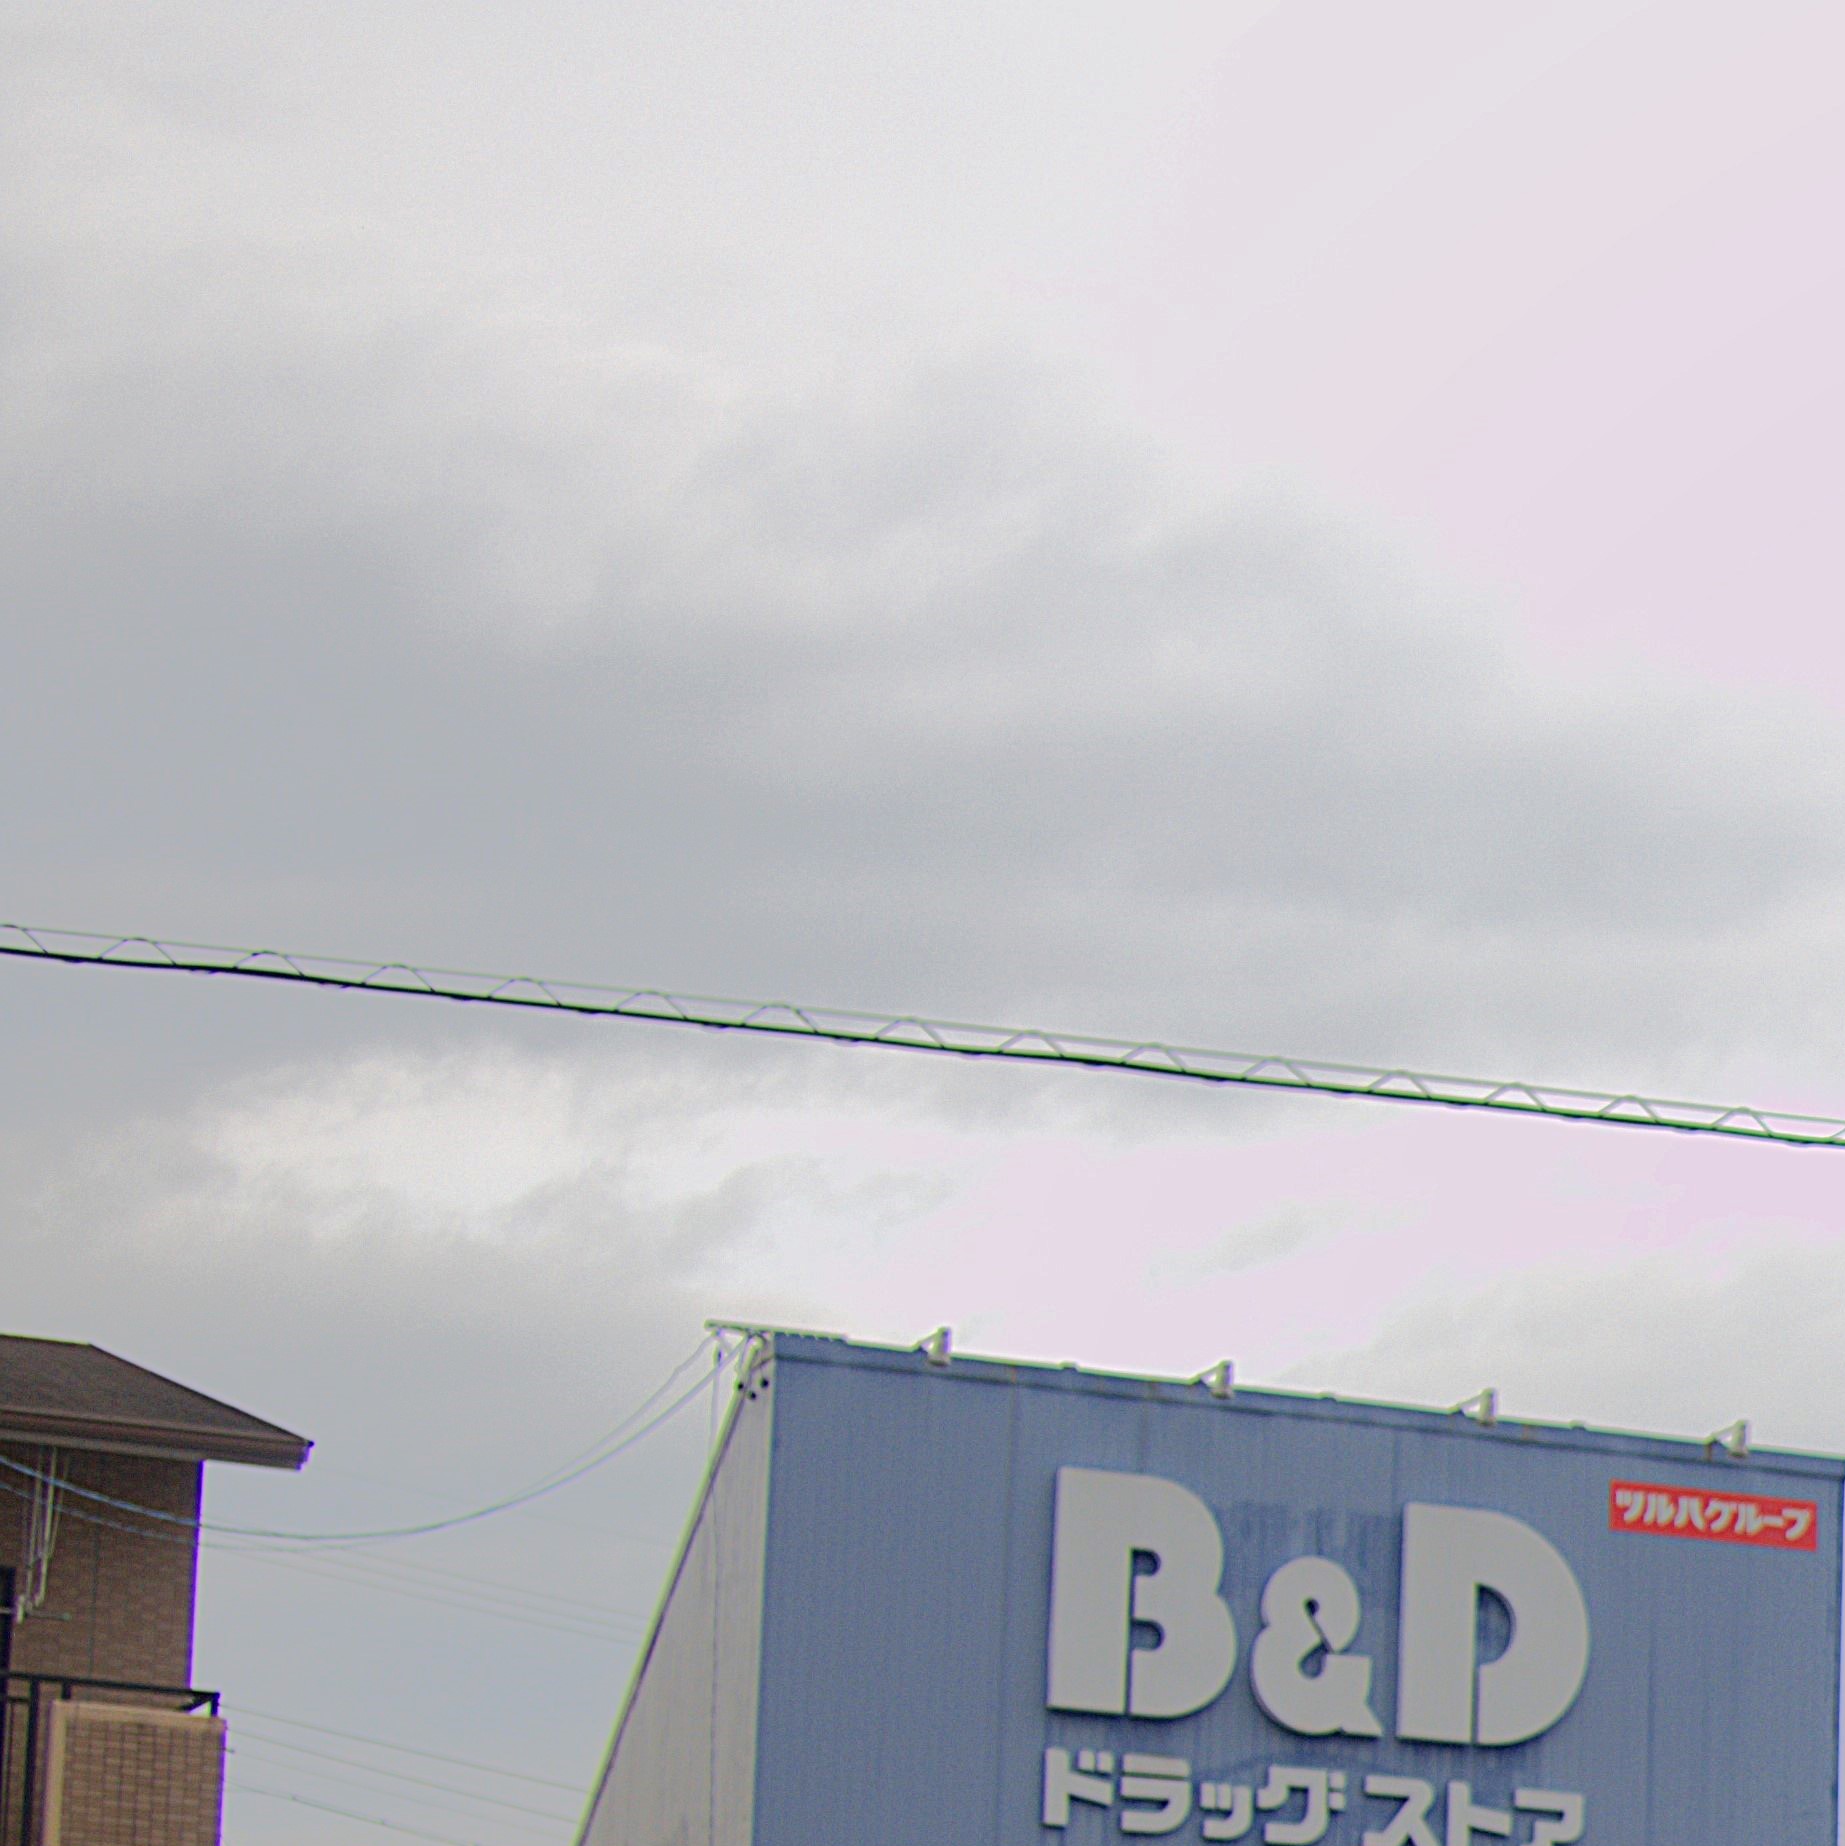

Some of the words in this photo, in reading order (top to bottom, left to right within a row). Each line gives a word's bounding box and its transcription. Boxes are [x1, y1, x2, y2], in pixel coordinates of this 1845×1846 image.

[1613, 1487, 1814, 1545] ツルハグループ
[1046, 1466, 1590, 1746] B&D
